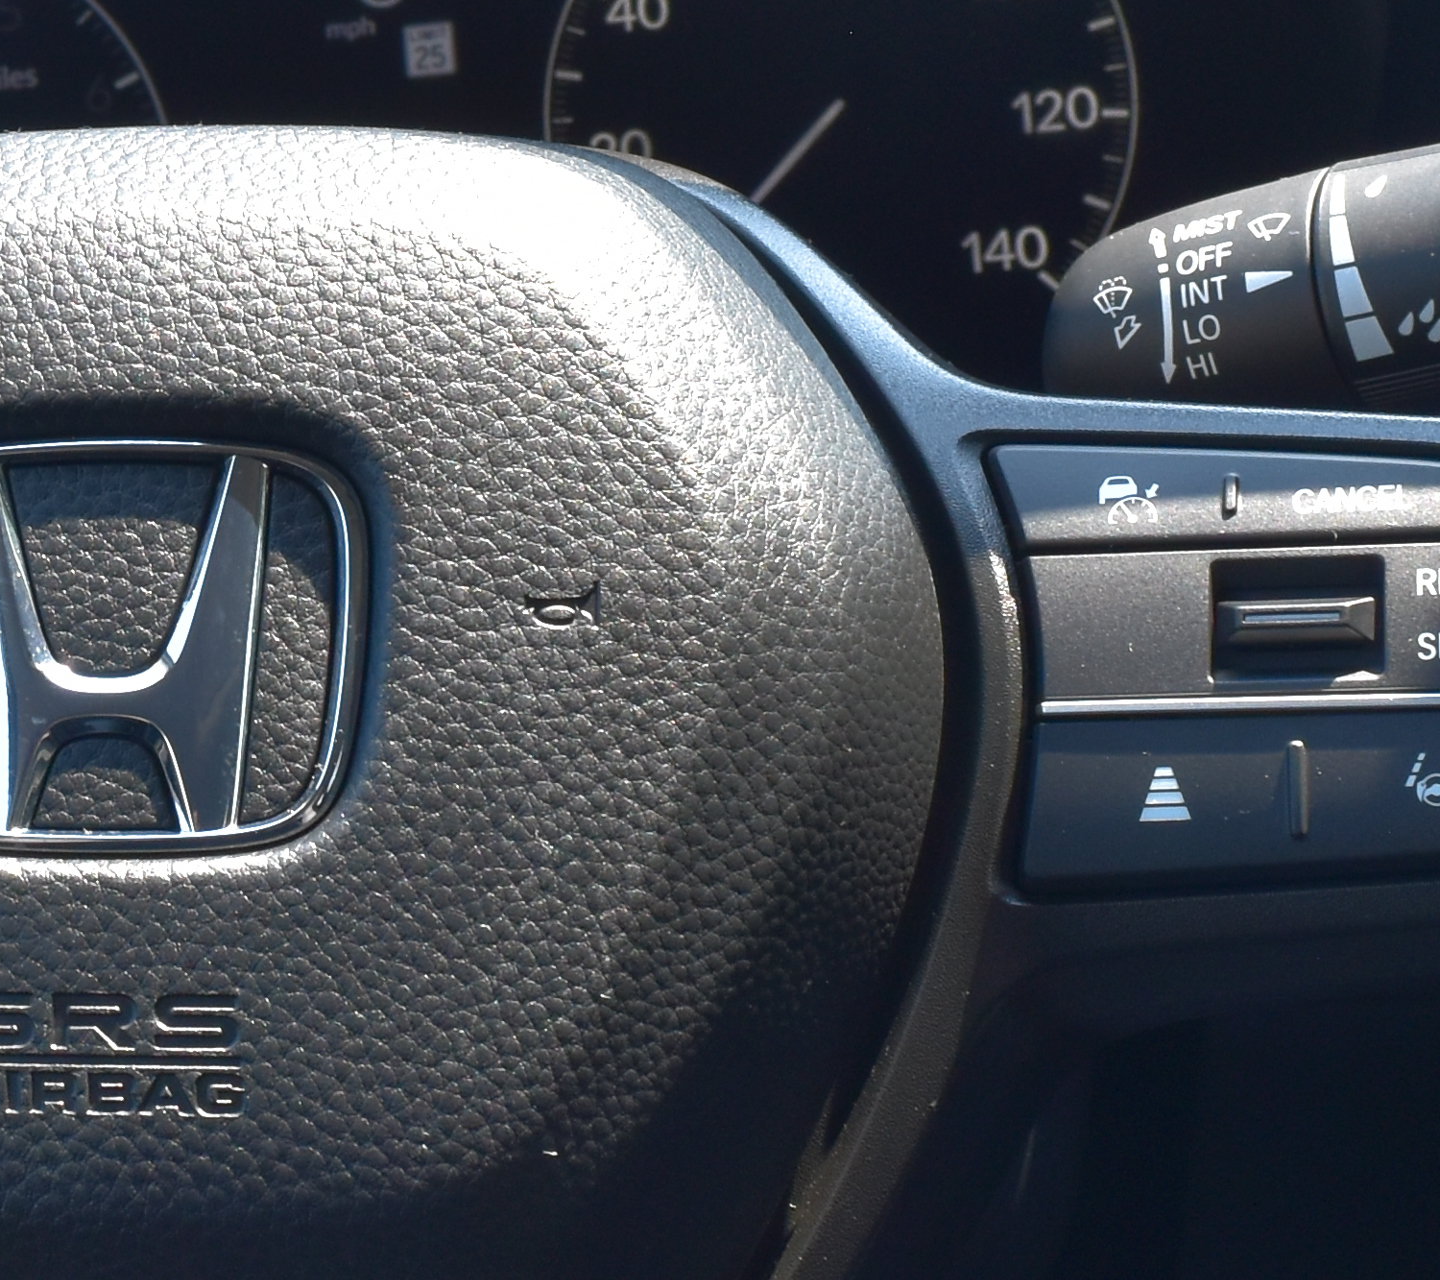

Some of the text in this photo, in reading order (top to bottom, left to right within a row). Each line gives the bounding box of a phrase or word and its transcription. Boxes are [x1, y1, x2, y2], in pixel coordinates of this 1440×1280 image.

[325, 16, 377, 42] mph
[415, 44, 446, 70] 25
[1011, 85, 1100, 135] 120
[1171, 209, 1243, 242] MIST
[961, 225, 1050, 273] 140
[1176, 246, 1232, 275] OFF
[1180, 276, 1228, 307] INT
[1185, 315, 1220, 344] LO
[1189, 355, 1219, 379] HI
[1291, 483, 1412, 515] CANCEL
